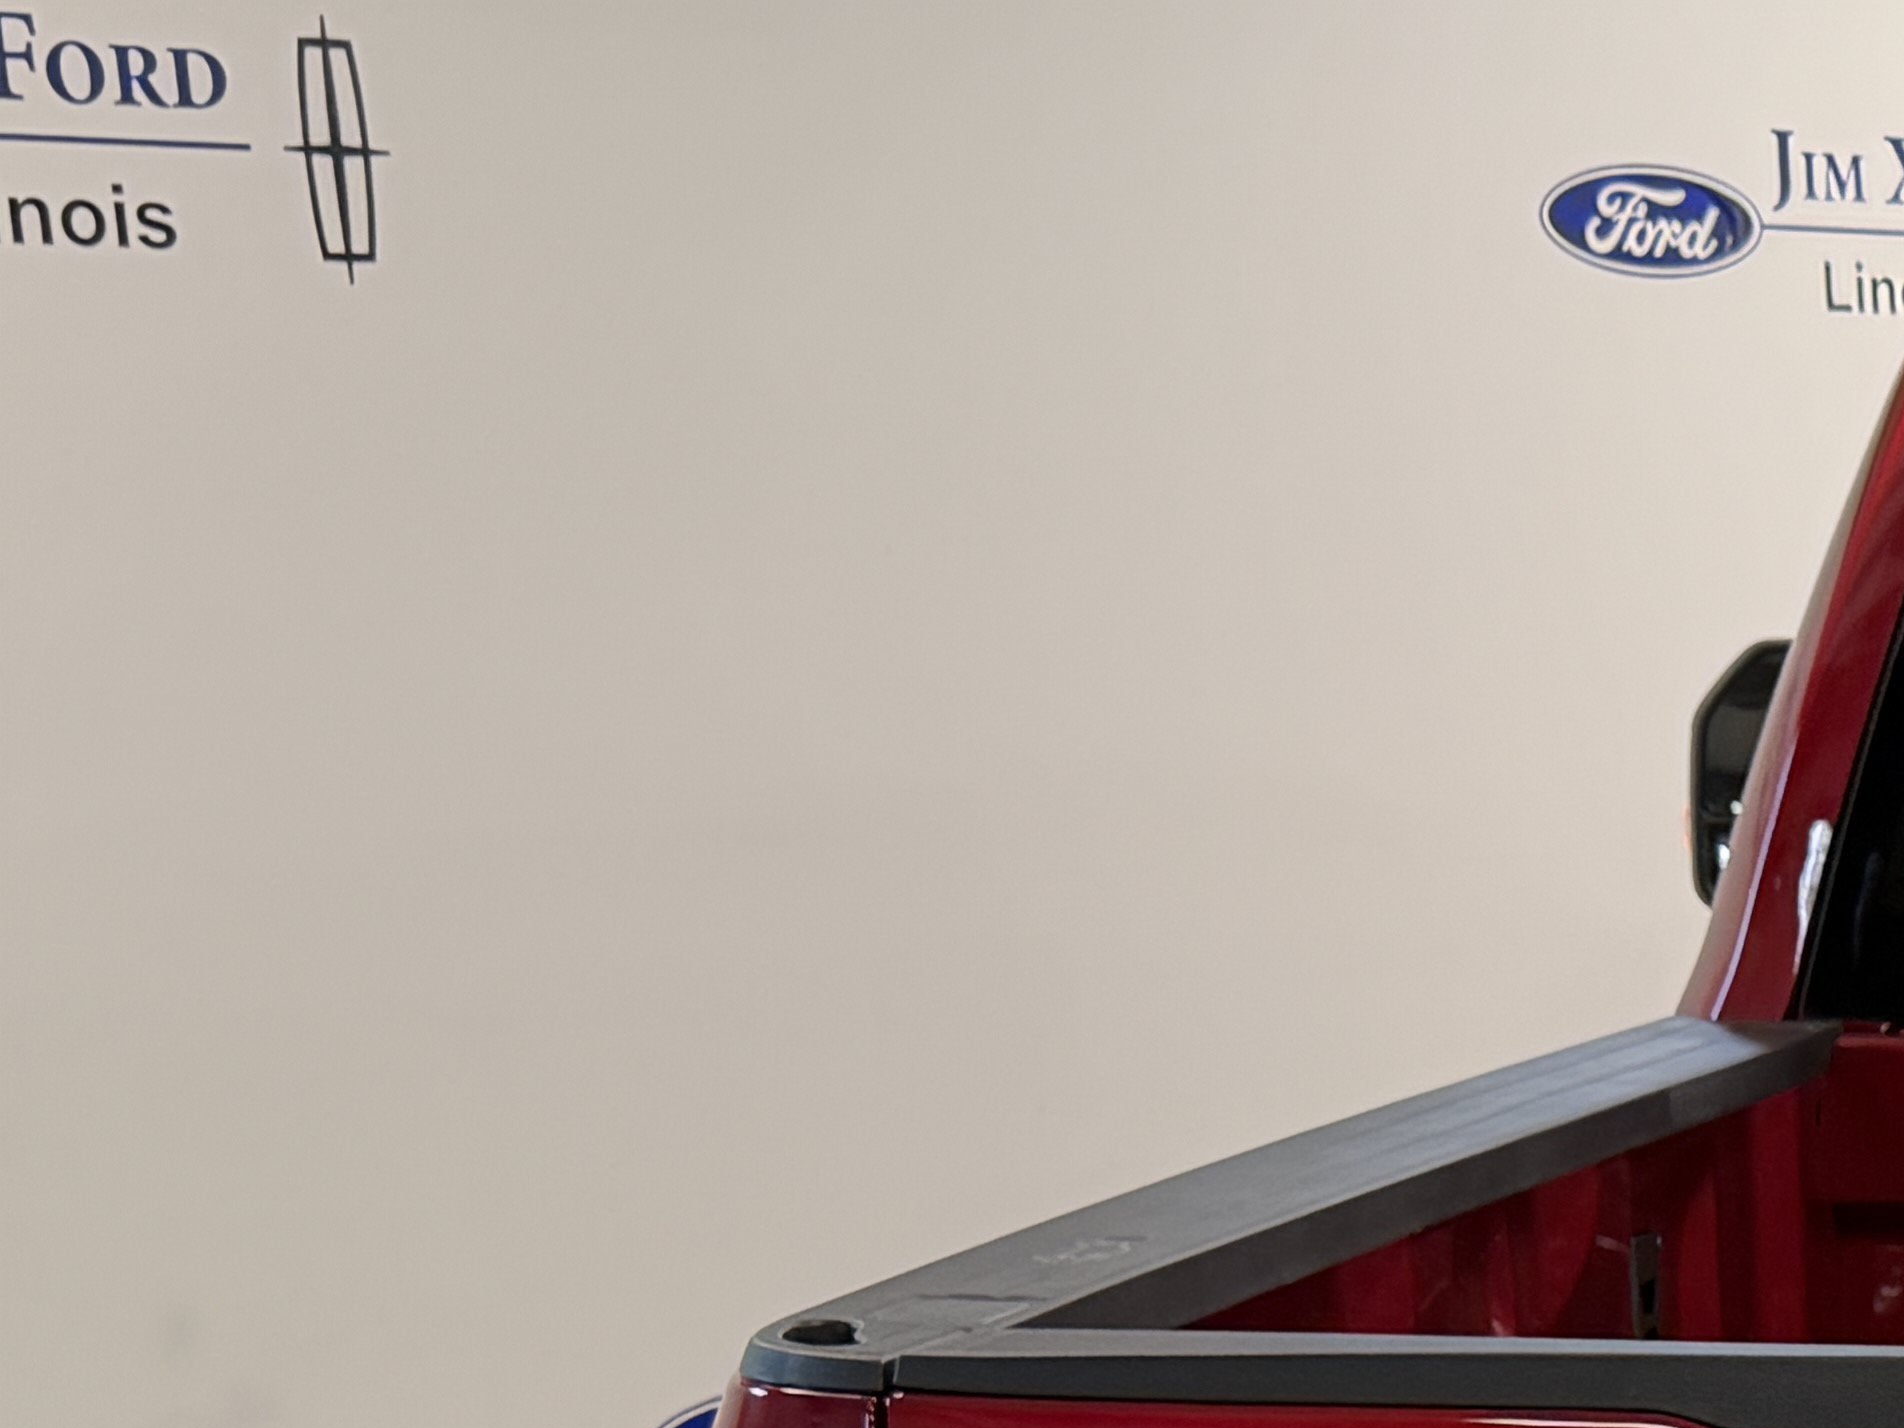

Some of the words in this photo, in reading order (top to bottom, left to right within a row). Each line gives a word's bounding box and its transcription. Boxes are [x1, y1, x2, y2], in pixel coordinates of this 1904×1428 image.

[1771, 129, 1867, 211] JIM
[0, 184, 178, 249] nois
[1585, 182, 1720, 260] Ford
